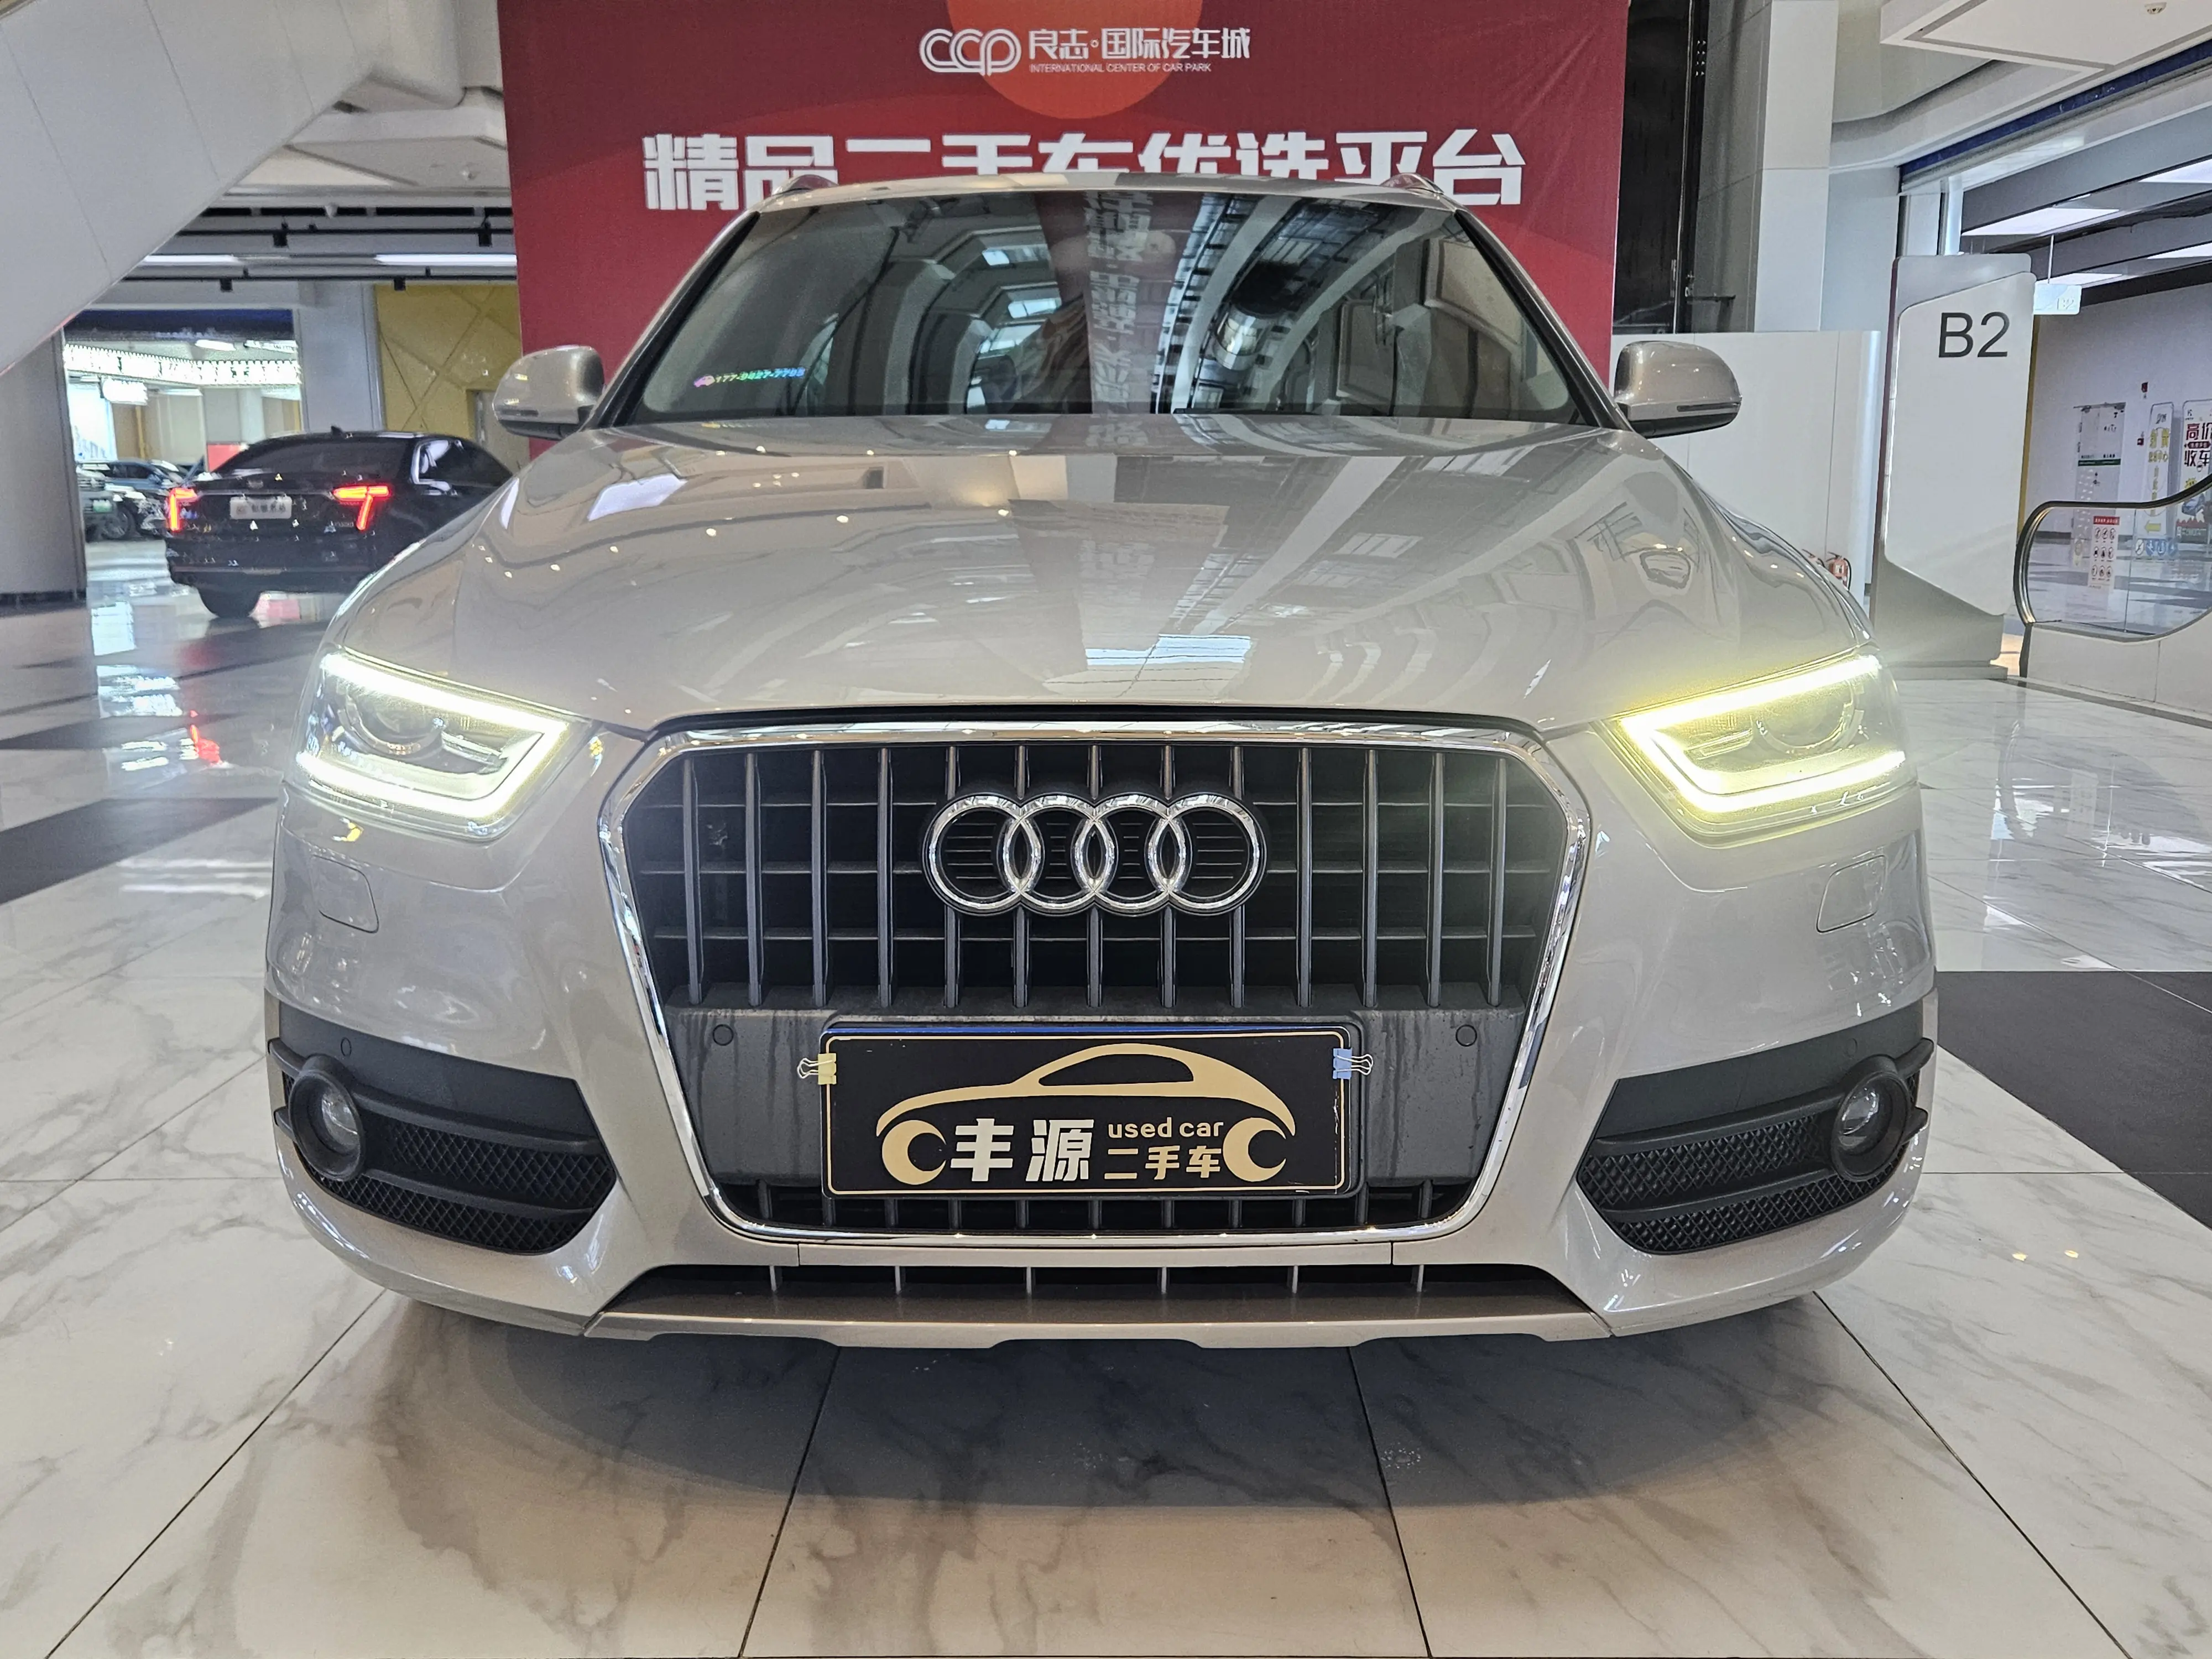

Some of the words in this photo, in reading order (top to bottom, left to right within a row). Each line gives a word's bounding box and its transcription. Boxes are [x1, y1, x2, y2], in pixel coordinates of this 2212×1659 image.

[1030, 63, 1104, 72] INTERNATIONAL
[1107, 63, 1146, 72] CENTER
[1147, 63, 1161, 72] OF
[1162, 63, 1183, 72] CAR
[1185, 63, 1212, 72] PARK
[1939, 311, 2010, 358] B2
[1108, 1117, 1172, 1138] used
[1179, 1121, 1224, 1138] car
[951, 1118, 1094, 1182] 丰源
[1104, 1146, 1221, 1180] 二手车
